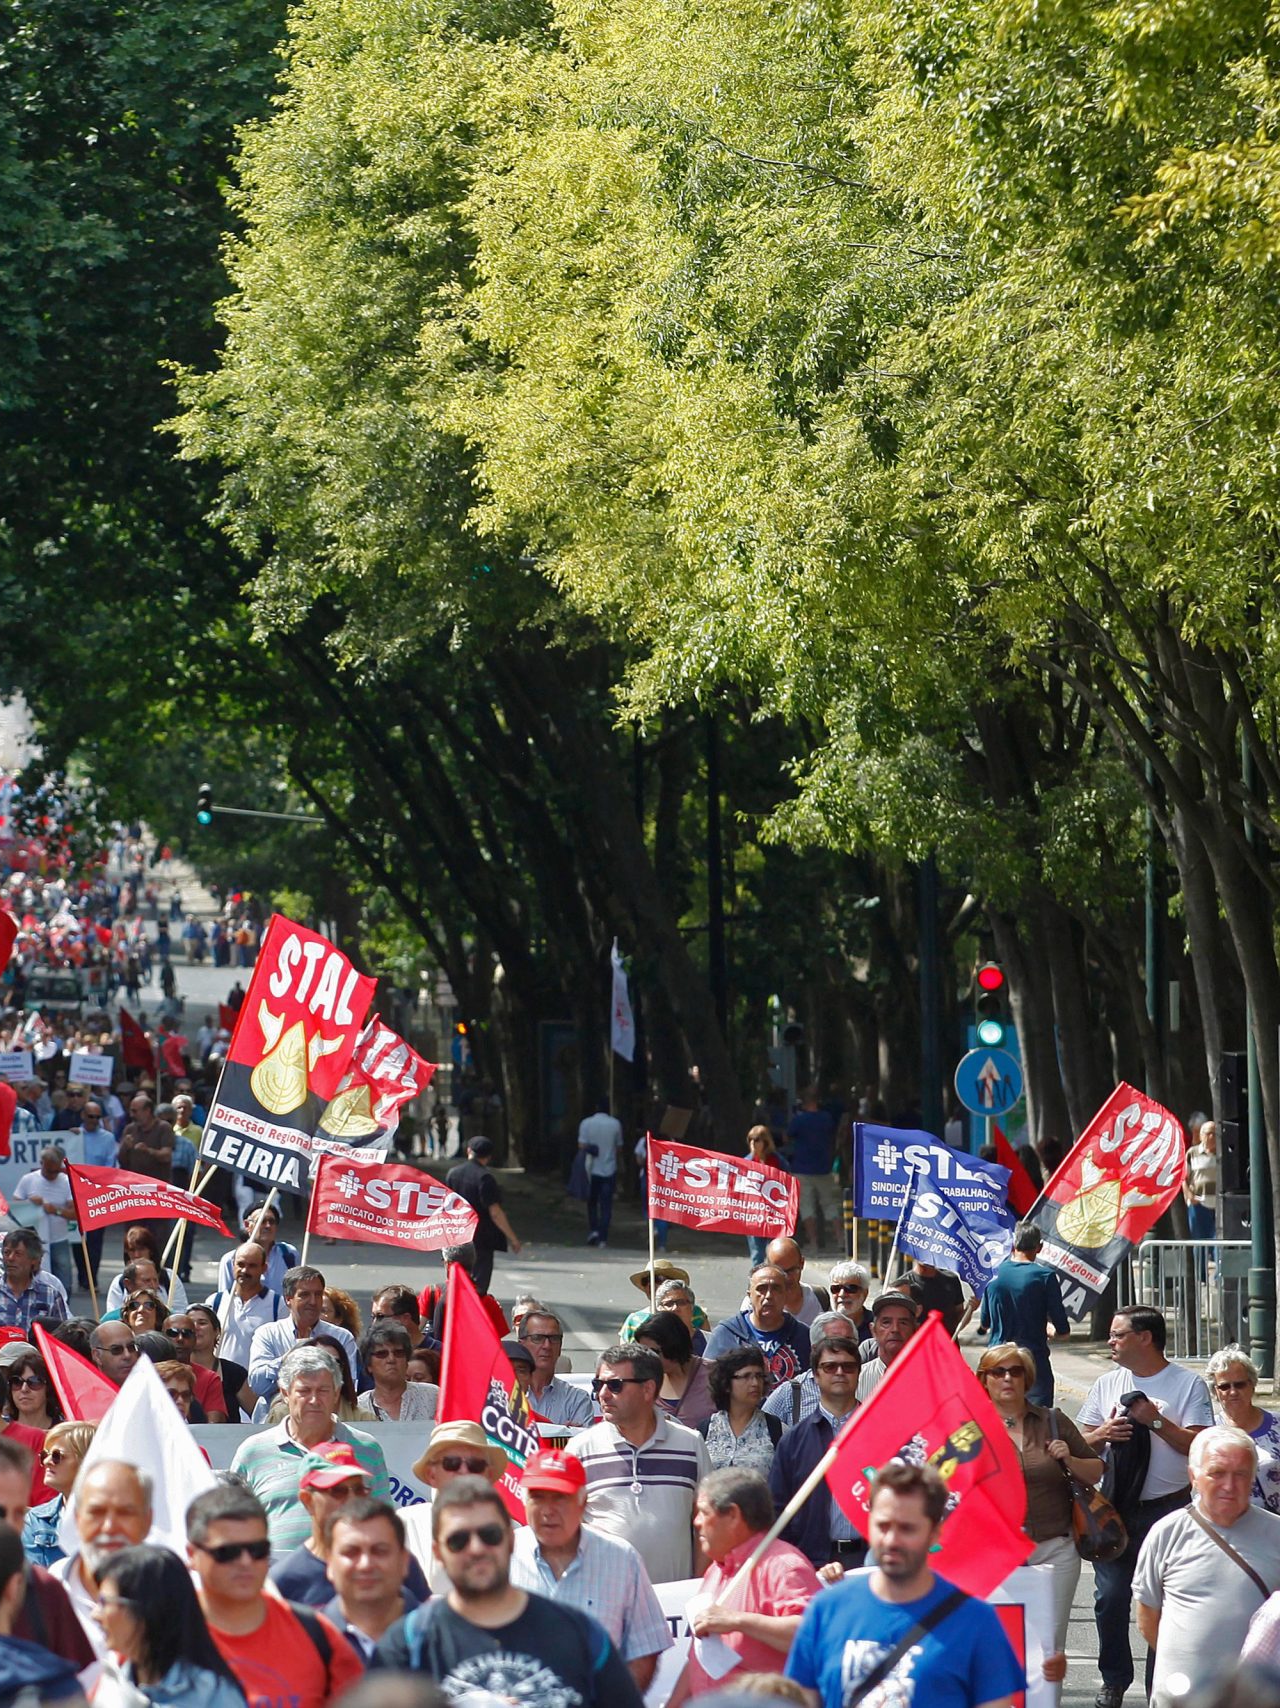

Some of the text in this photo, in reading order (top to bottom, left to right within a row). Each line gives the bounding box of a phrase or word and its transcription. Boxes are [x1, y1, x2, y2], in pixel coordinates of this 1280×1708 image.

[270, 933, 359, 1026] STAL
[215, 1108, 264, 1135] Direcção
[1099, 1103, 1181, 1187] STAL
[202, 1129, 300, 1189] LEIRIA
[650, 1184, 696, 1204] SINDICATO
[697, 1195, 715, 1205] DOS
[684, 1158, 788, 1208] STEC
[87, 1189, 131, 1207] SINDICATO
[89, 1207, 107, 1218] DAS
[109, 1199, 157, 1213] EMPRESAS
[160, 1201, 173, 1209] DO
[364, 1179, 472, 1217] STEC
[649, 1197, 667, 1208] DAS
[669, 1202, 716, 1219] EMPRESAS
[732, 1211, 764, 1225] GRUPO
[871, 1195, 889, 1207] DAS
[327, 1214, 346, 1225] DAS
[347, 1220, 395, 1238] EMPRESAS
[397, 1231, 411, 1240] DO
[413, 1226, 444, 1240] GRUPO
[329, 1202, 375, 1222] SINDICATO
[375, 1215, 394, 1228] DOS
[915, 1223, 933, 1237] DOS
[482, 1405, 540, 1457] CGTP
